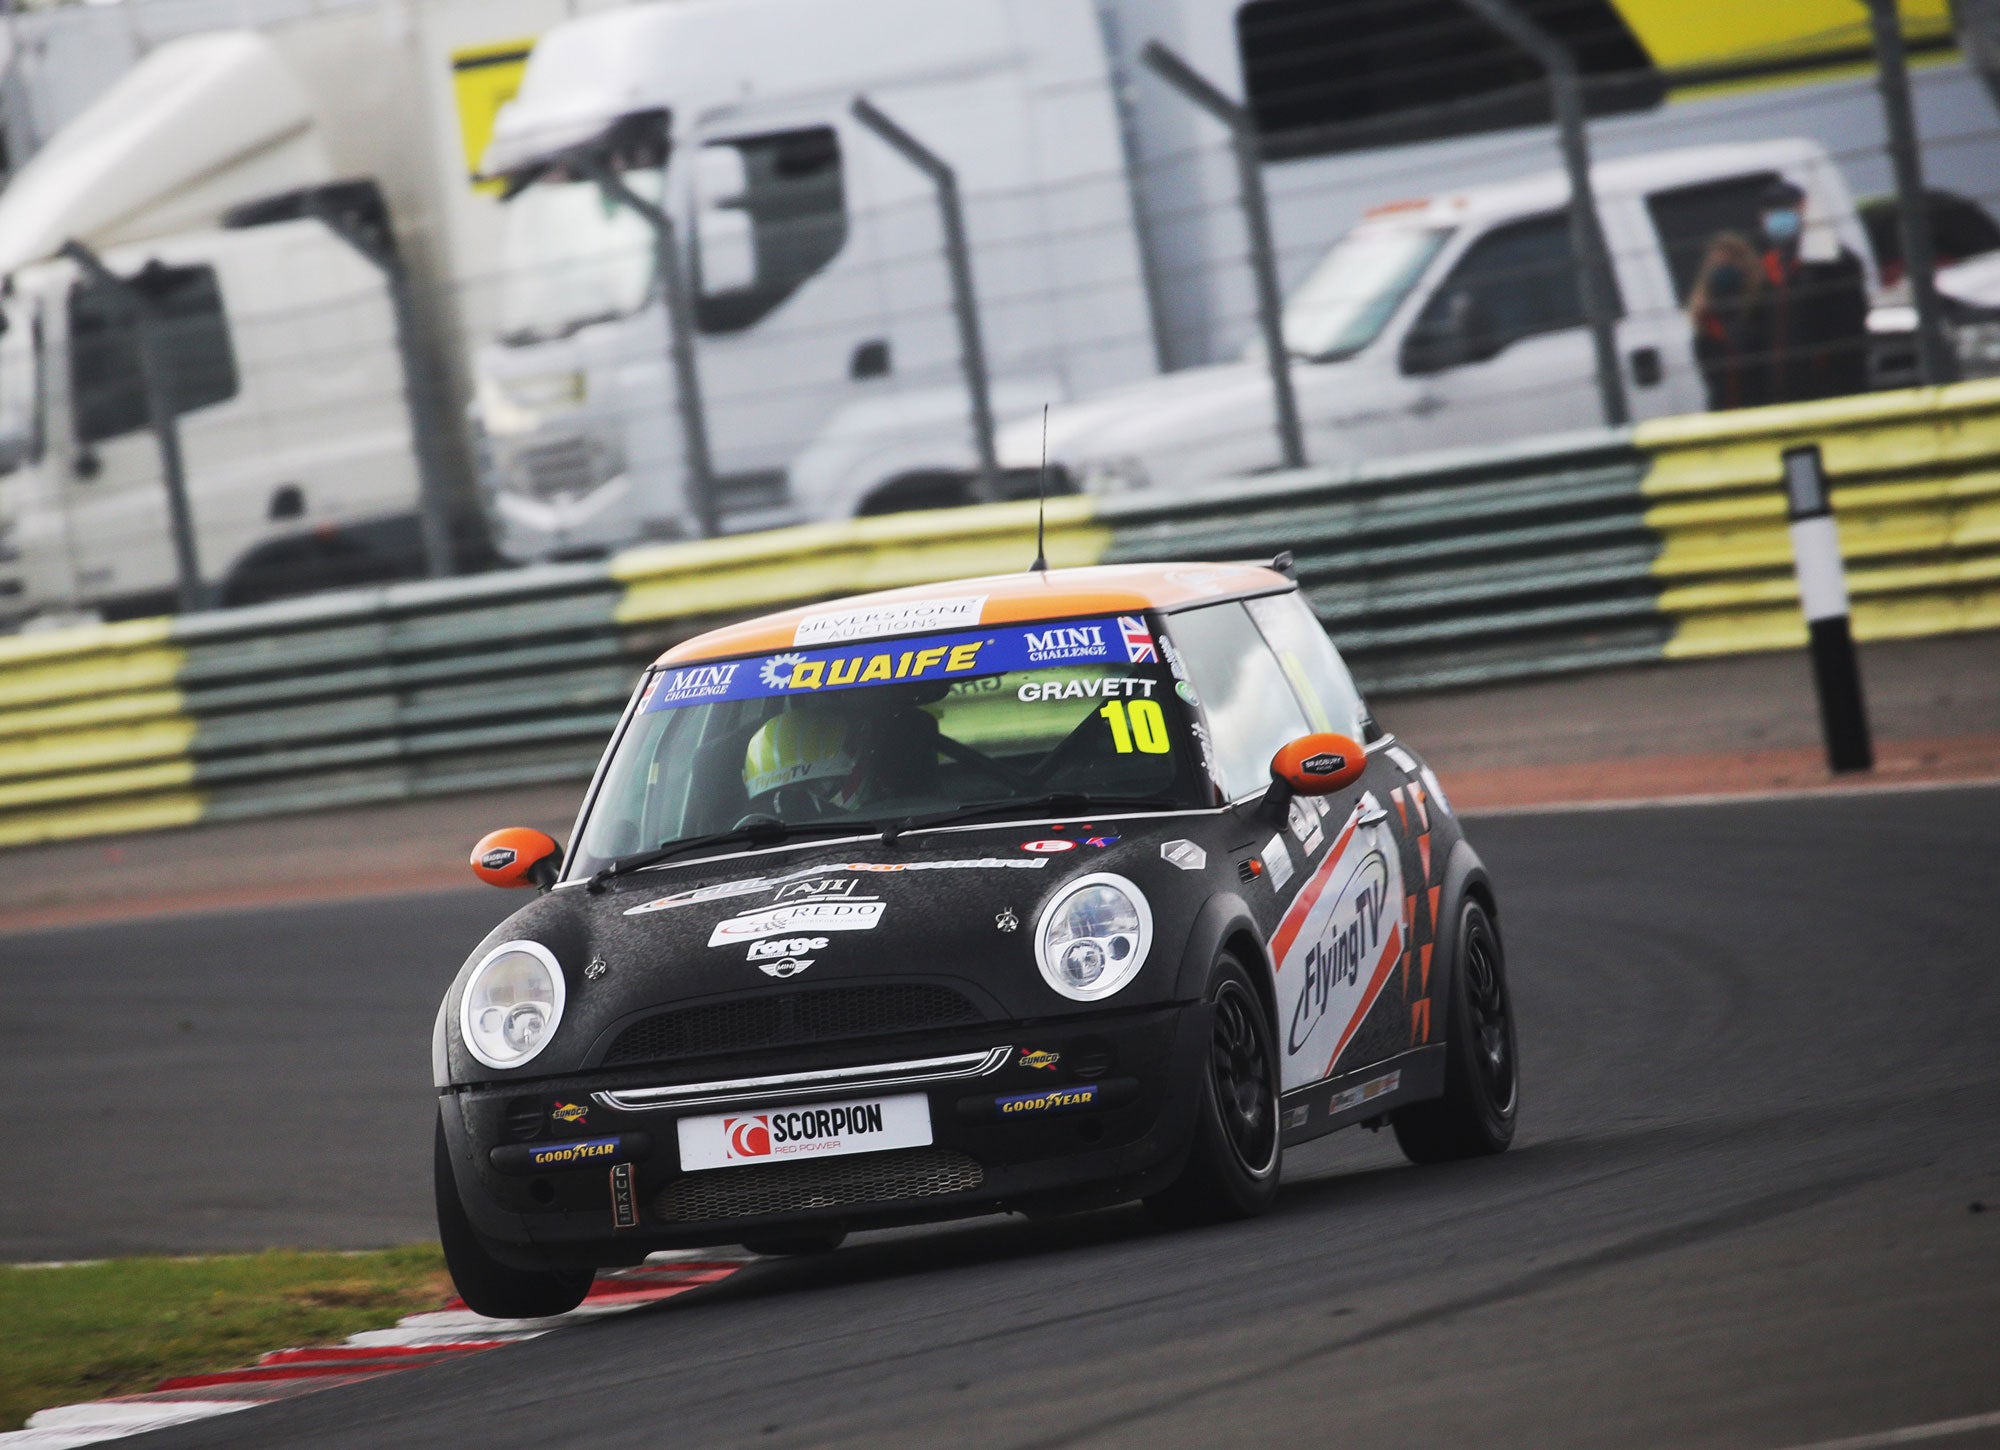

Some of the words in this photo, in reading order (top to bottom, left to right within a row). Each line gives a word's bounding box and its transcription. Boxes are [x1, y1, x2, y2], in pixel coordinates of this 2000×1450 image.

[800, 603, 973, 633] SILVERSTONE
[828, 617, 937, 640] AUCTIONS
[1024, 626, 1106, 653] MINI
[788, 640, 983, 690] QUAIFE
[1029, 645, 1108, 662] CHALLENGE
[669, 664, 740, 692] MINI
[1017, 677, 1158, 702] GRAVETT
[664, 684, 729, 702] CHALLENGE
[1100, 699, 1171, 755] 10
[772, 905, 877, 921] CREDO
[1304, 878, 1380, 1021] FlyingTV
[1021, 1054, 1058, 1065] SUNOCO
[554, 1106, 587, 1119] SUNOCO
[1002, 1092, 1092, 1112] GOODYEAR
[773, 1103, 883, 1143] SCORPION
[535, 1144, 615, 1163] GOODYEAR
[775, 1145, 797, 1155] RED
[799, 1141, 841, 1152] POWER
